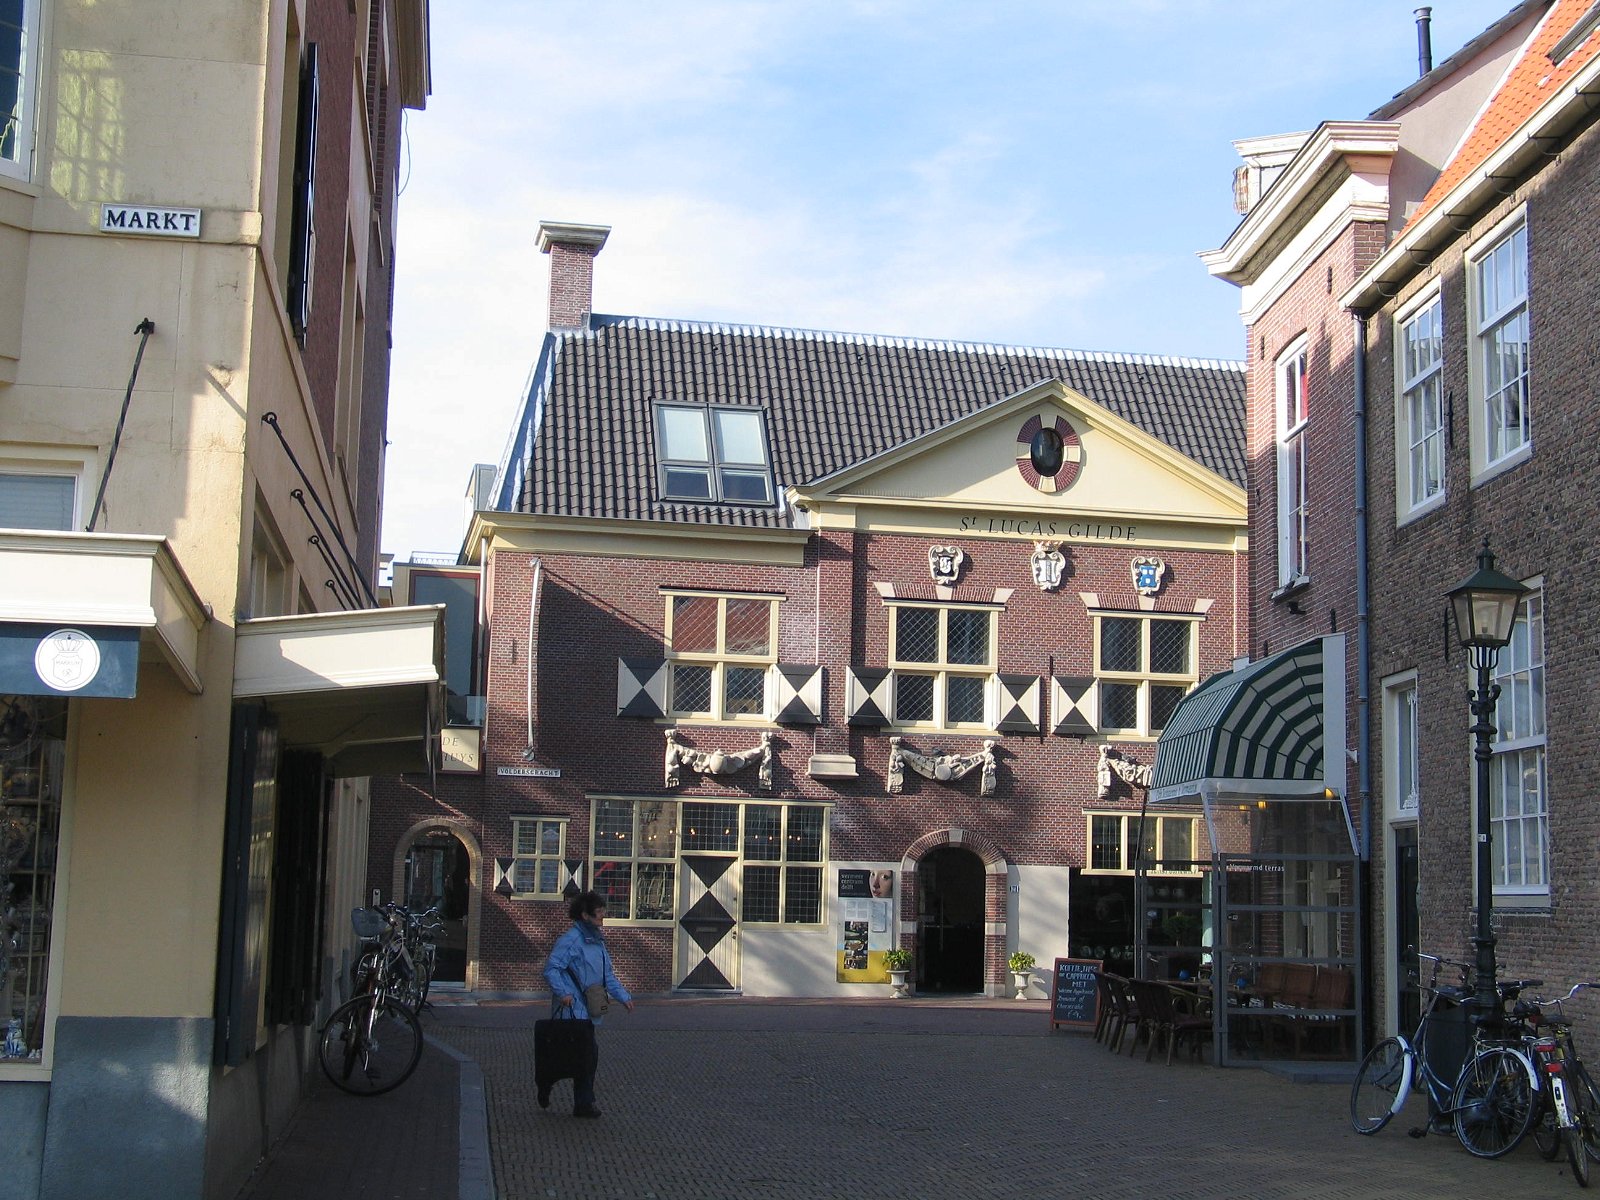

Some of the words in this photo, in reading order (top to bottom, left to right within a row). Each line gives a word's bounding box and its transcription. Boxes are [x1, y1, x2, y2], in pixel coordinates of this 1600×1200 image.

[106, 209, 196, 231] MARKT
[988, 519, 1058, 537] LUCAS
[1068, 523, 1137, 541] GILDE
[443, 737, 459, 746] DE
[1264, 864, 1285, 872] terras
